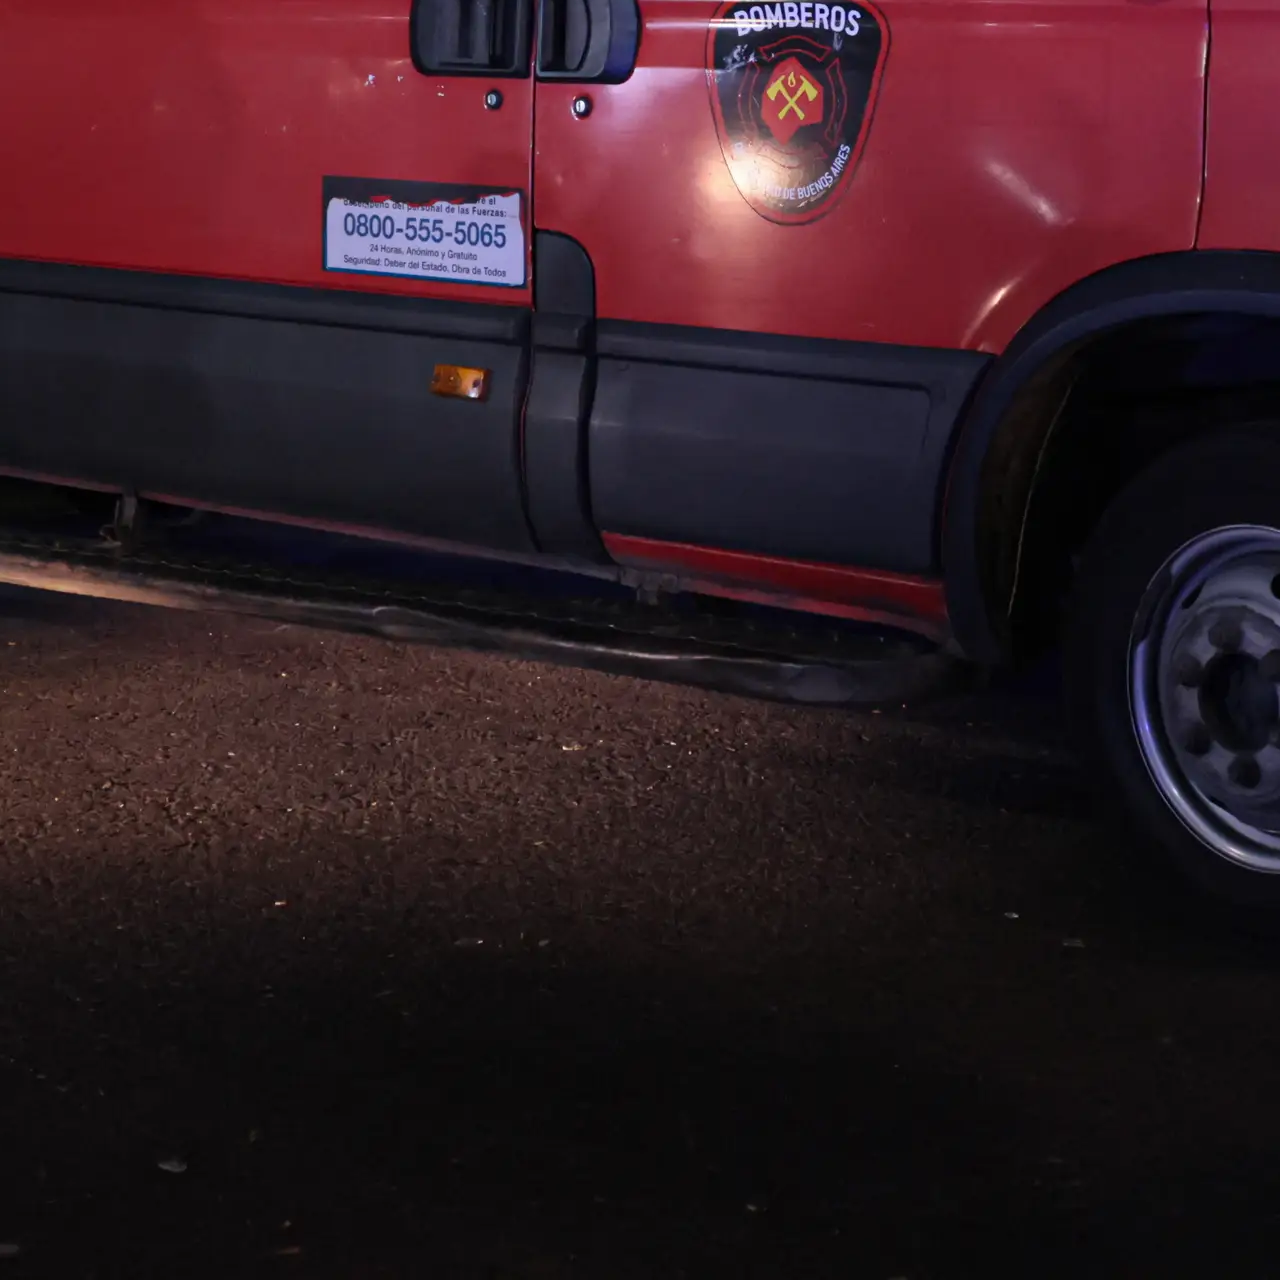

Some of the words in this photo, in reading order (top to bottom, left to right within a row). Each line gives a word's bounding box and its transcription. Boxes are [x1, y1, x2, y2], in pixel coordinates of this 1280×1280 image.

[734, 2, 861, 37] BOMBEROS
[797, 172, 834, 199] BUENOS
[830, 143, 851, 177] AIRES
[445, 205, 455, 214] de
[458, 206, 470, 215] las
[344, 212, 507, 248] 0800-555-5065
[369, 244, 379, 252] 24
[441, 251, 445, 260] y
[447, 250, 478, 261] Gratuito
[384, 258, 407, 268] Deber
[408, 261, 420, 269] del
[452, 264, 470, 274] Obra
[472, 266, 482, 275] de
[484, 267, 507, 277] Todos
